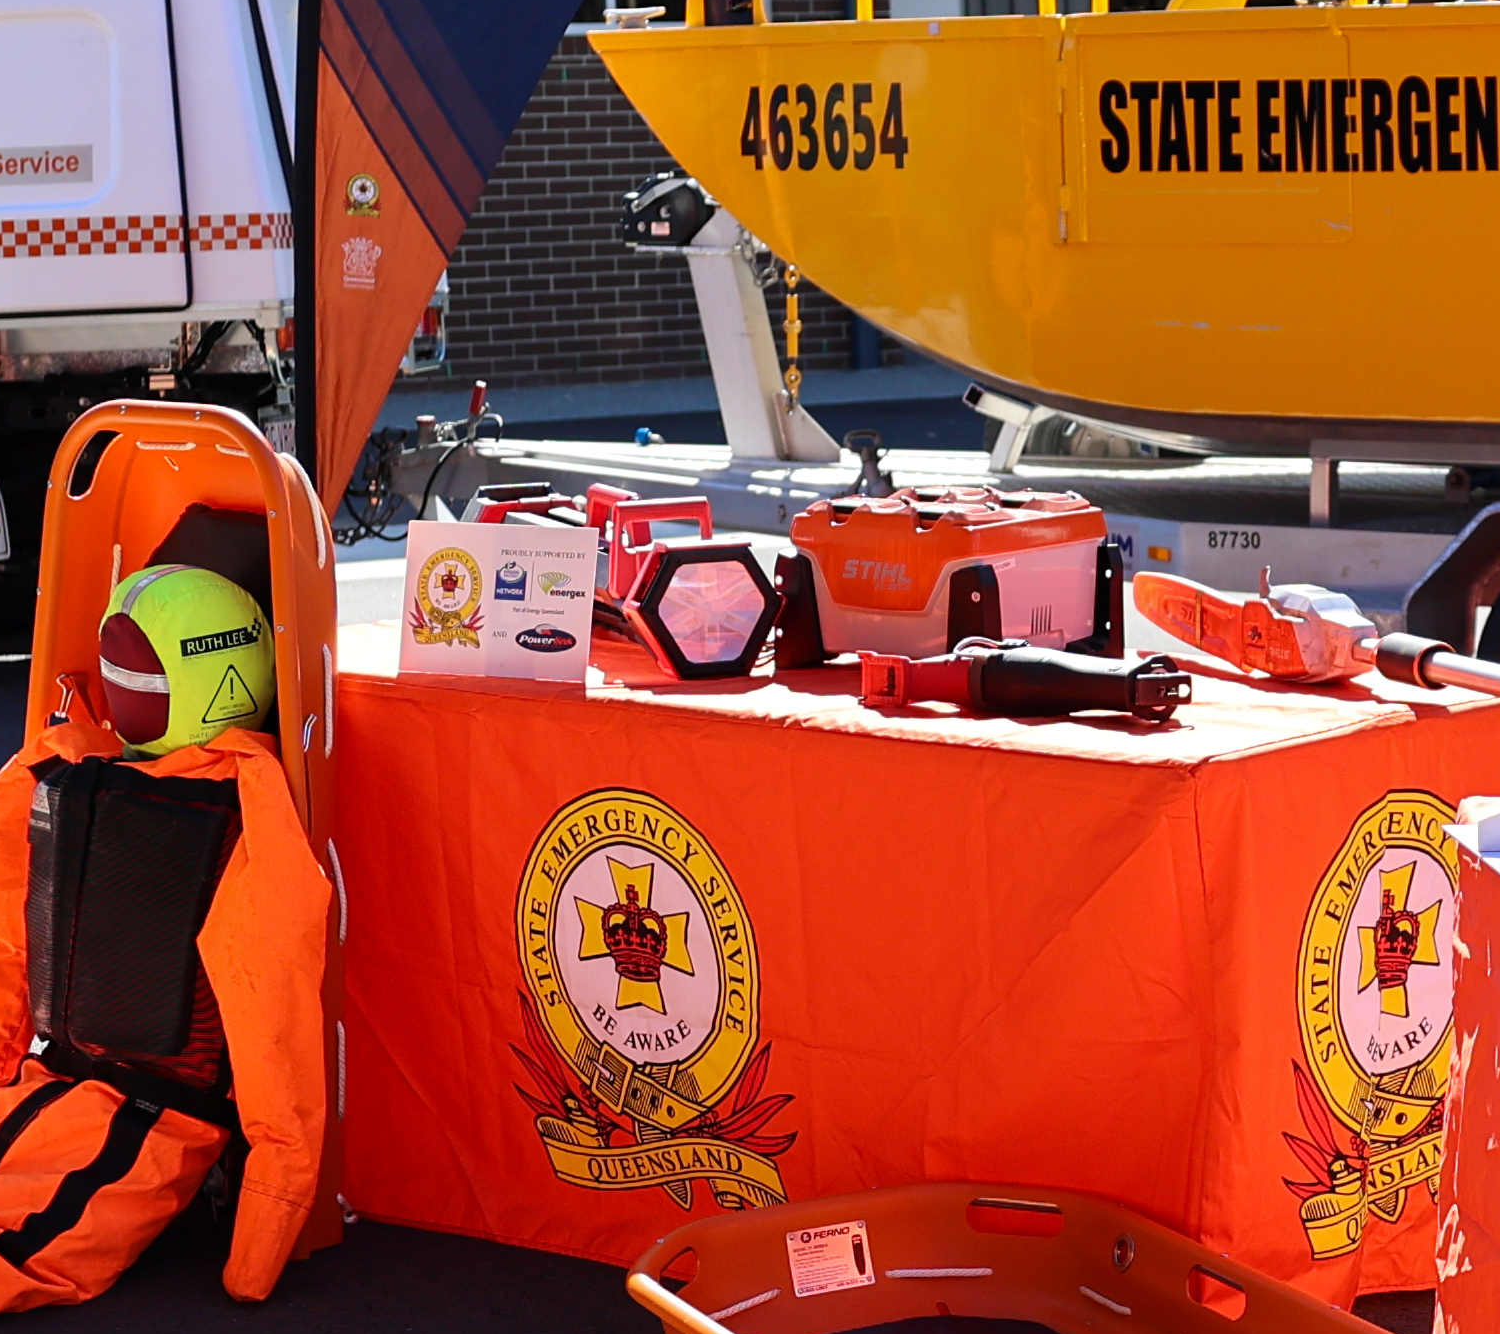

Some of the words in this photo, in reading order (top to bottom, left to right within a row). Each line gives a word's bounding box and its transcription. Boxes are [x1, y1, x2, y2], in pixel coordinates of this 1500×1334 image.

[740, 82, 909, 170] 463654
[1100, 78, 1244, 174] STATE
[501, 549, 532, 557] PROUDLY
[534, 550, 575, 559] SUPPORTED
[577, 552, 586, 560] BY
[1208, 531, 1261, 549] 87730
[843, 559, 913, 583] STIHL
[550, 589, 586, 599] energex
[187, 635, 224, 654] RUTH
[226, 630, 247, 646] LEE
[519, 635, 573, 645] Powerlink
[540, 809, 699, 882] EMERGENCY
[528, 897, 563, 1007] STATE
[703, 876, 746, 1034] SERVICE
[1311, 945, 1338, 1064] STATE
[592, 1003, 617, 1036] BE
[623, 1019, 692, 1052] AWARE
[587, 1148, 743, 1183] QUEENSLAND
[814, 1227, 850, 1240] FERNO
